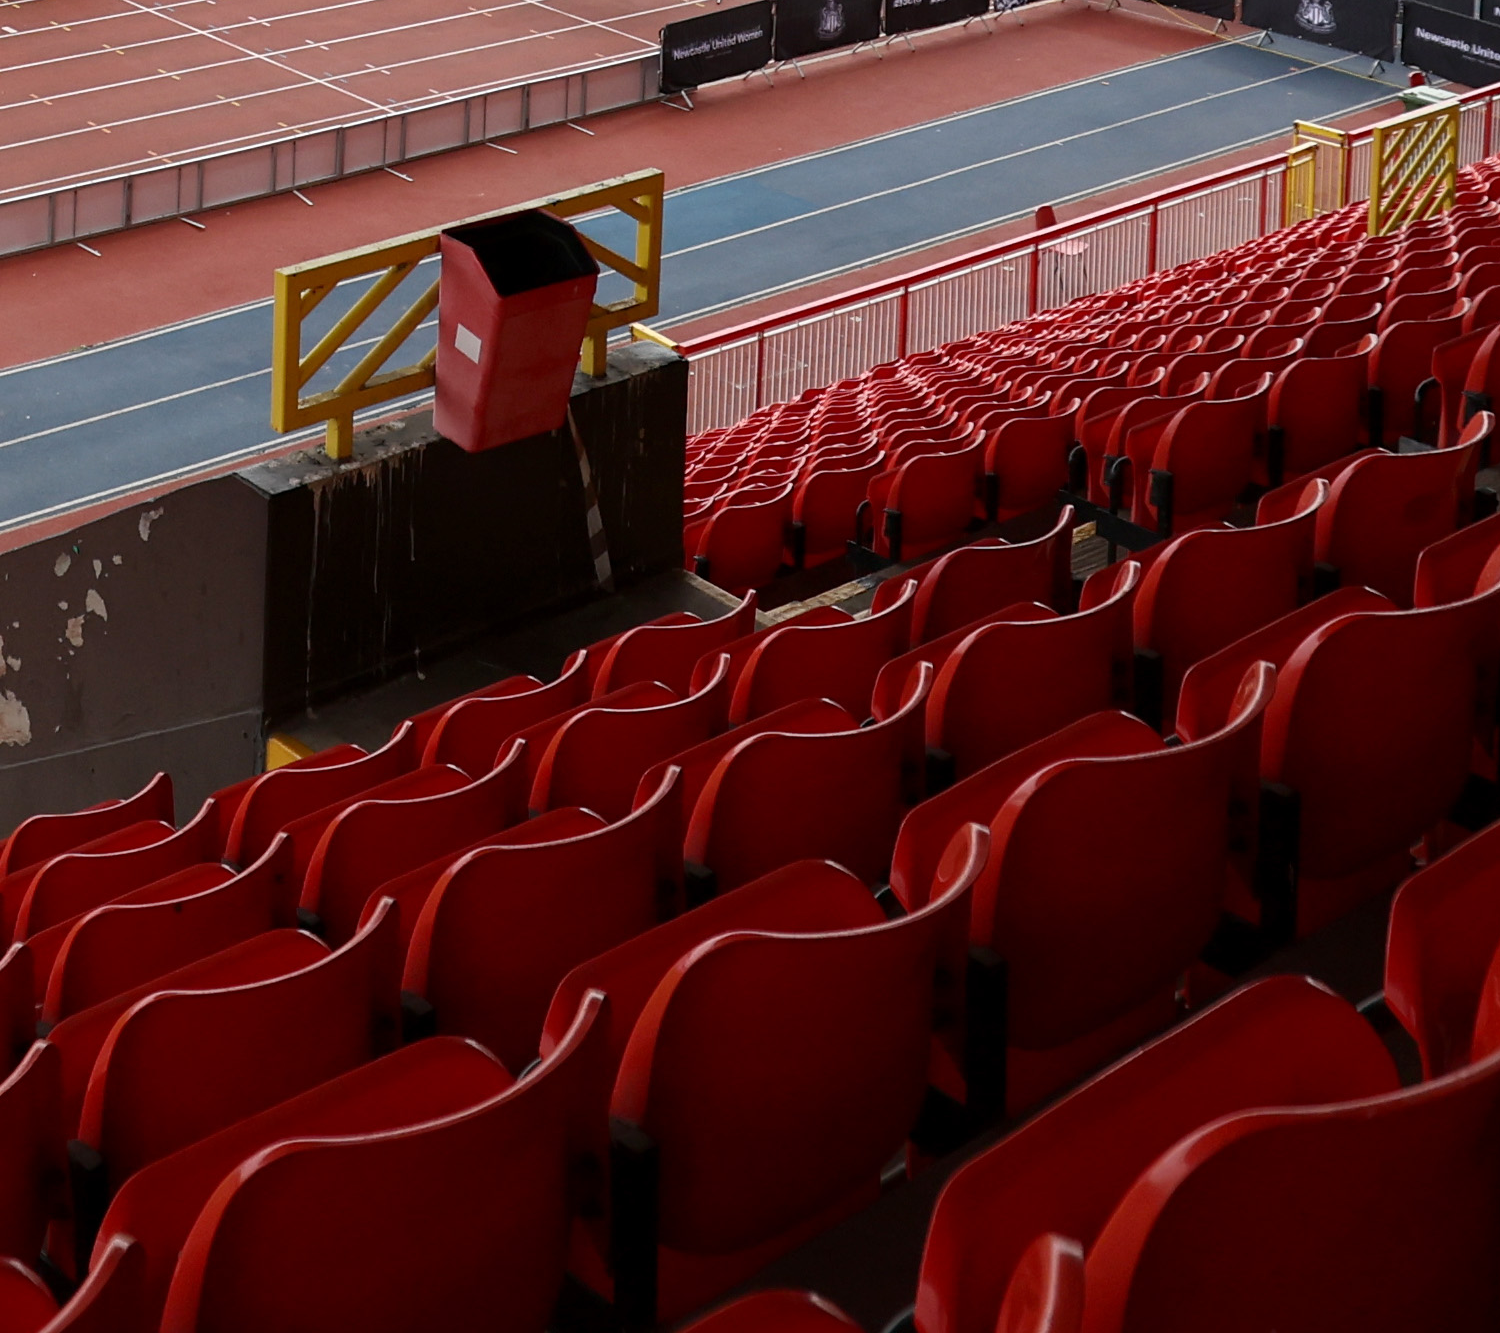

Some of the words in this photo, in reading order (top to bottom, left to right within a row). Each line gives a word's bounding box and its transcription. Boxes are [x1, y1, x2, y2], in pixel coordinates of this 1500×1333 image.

[672, 42, 711, 61] Newcastle
[711, 34, 737, 51] United
[737, 28, 764, 45] Women
[1415, 26, 1470, 52] Newcastle
